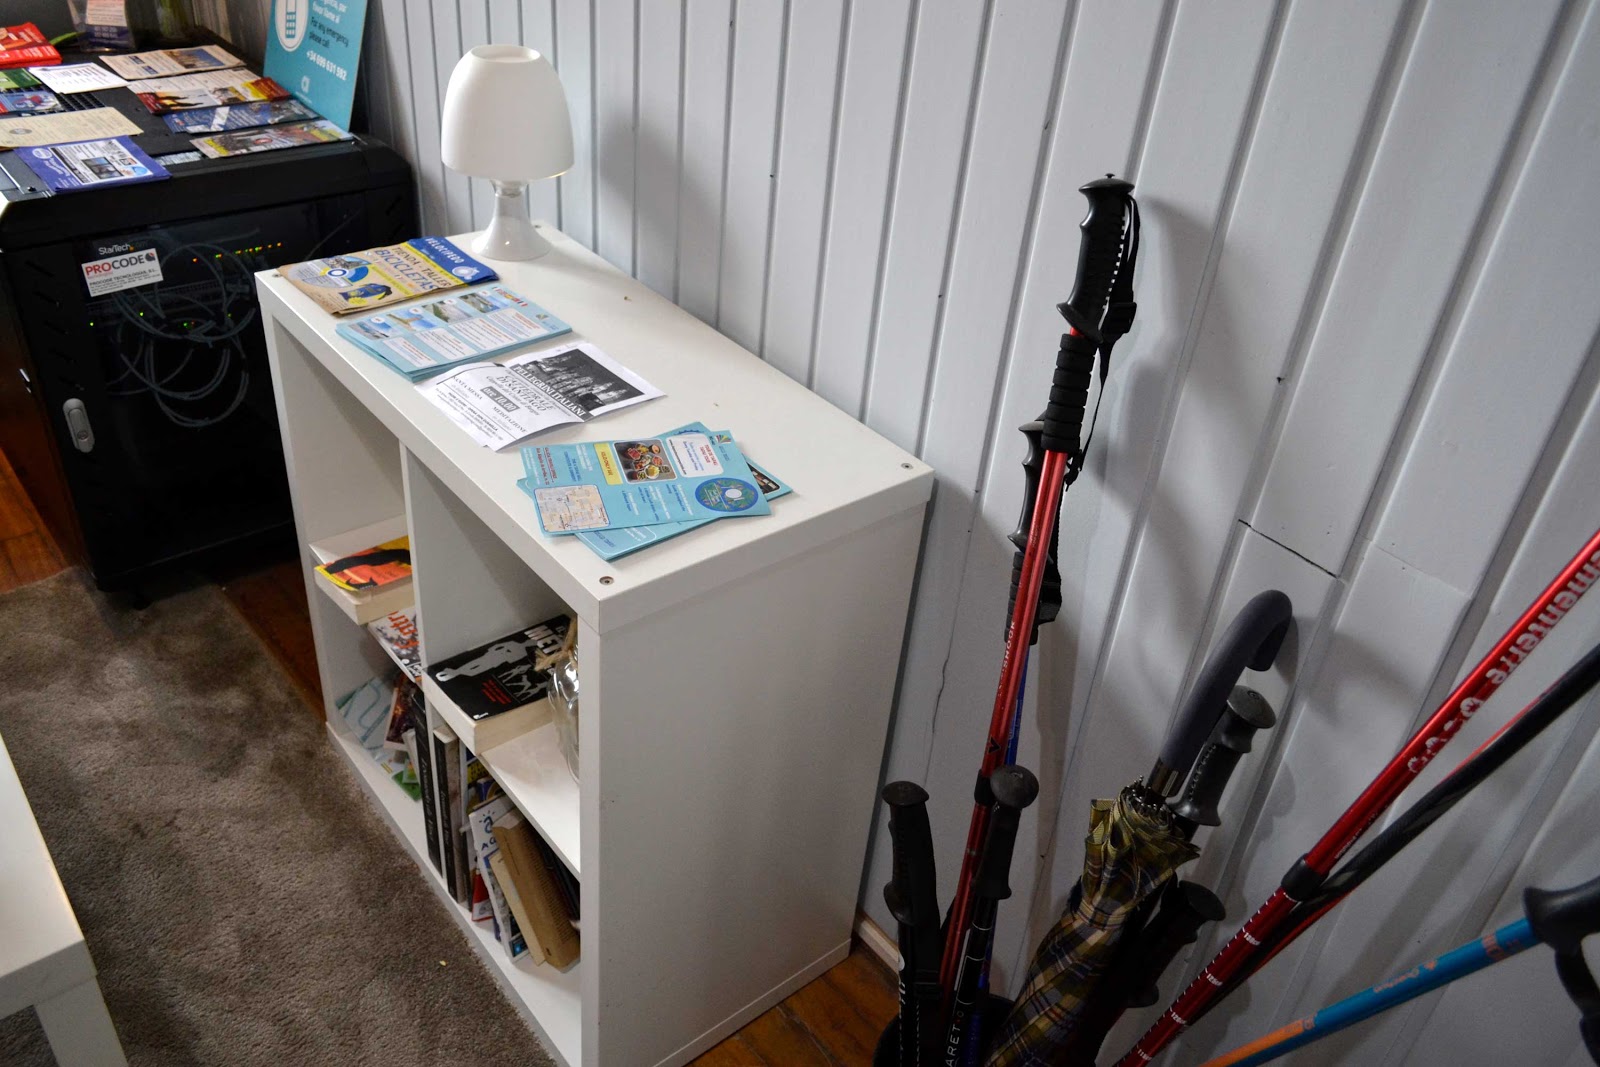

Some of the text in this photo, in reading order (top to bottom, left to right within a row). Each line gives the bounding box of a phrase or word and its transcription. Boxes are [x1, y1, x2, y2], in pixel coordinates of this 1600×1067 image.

[85, 254, 145, 276] PROCODE
[374, 249, 438, 290] BICICLETAS
[392, 247, 420, 265] TIENDA
[422, 268, 452, 286] TALLER
[484, 388, 497, 397] ore
[513, 366, 556, 396] PELLEGRINI
[552, 392, 586, 416] ITALIANI
